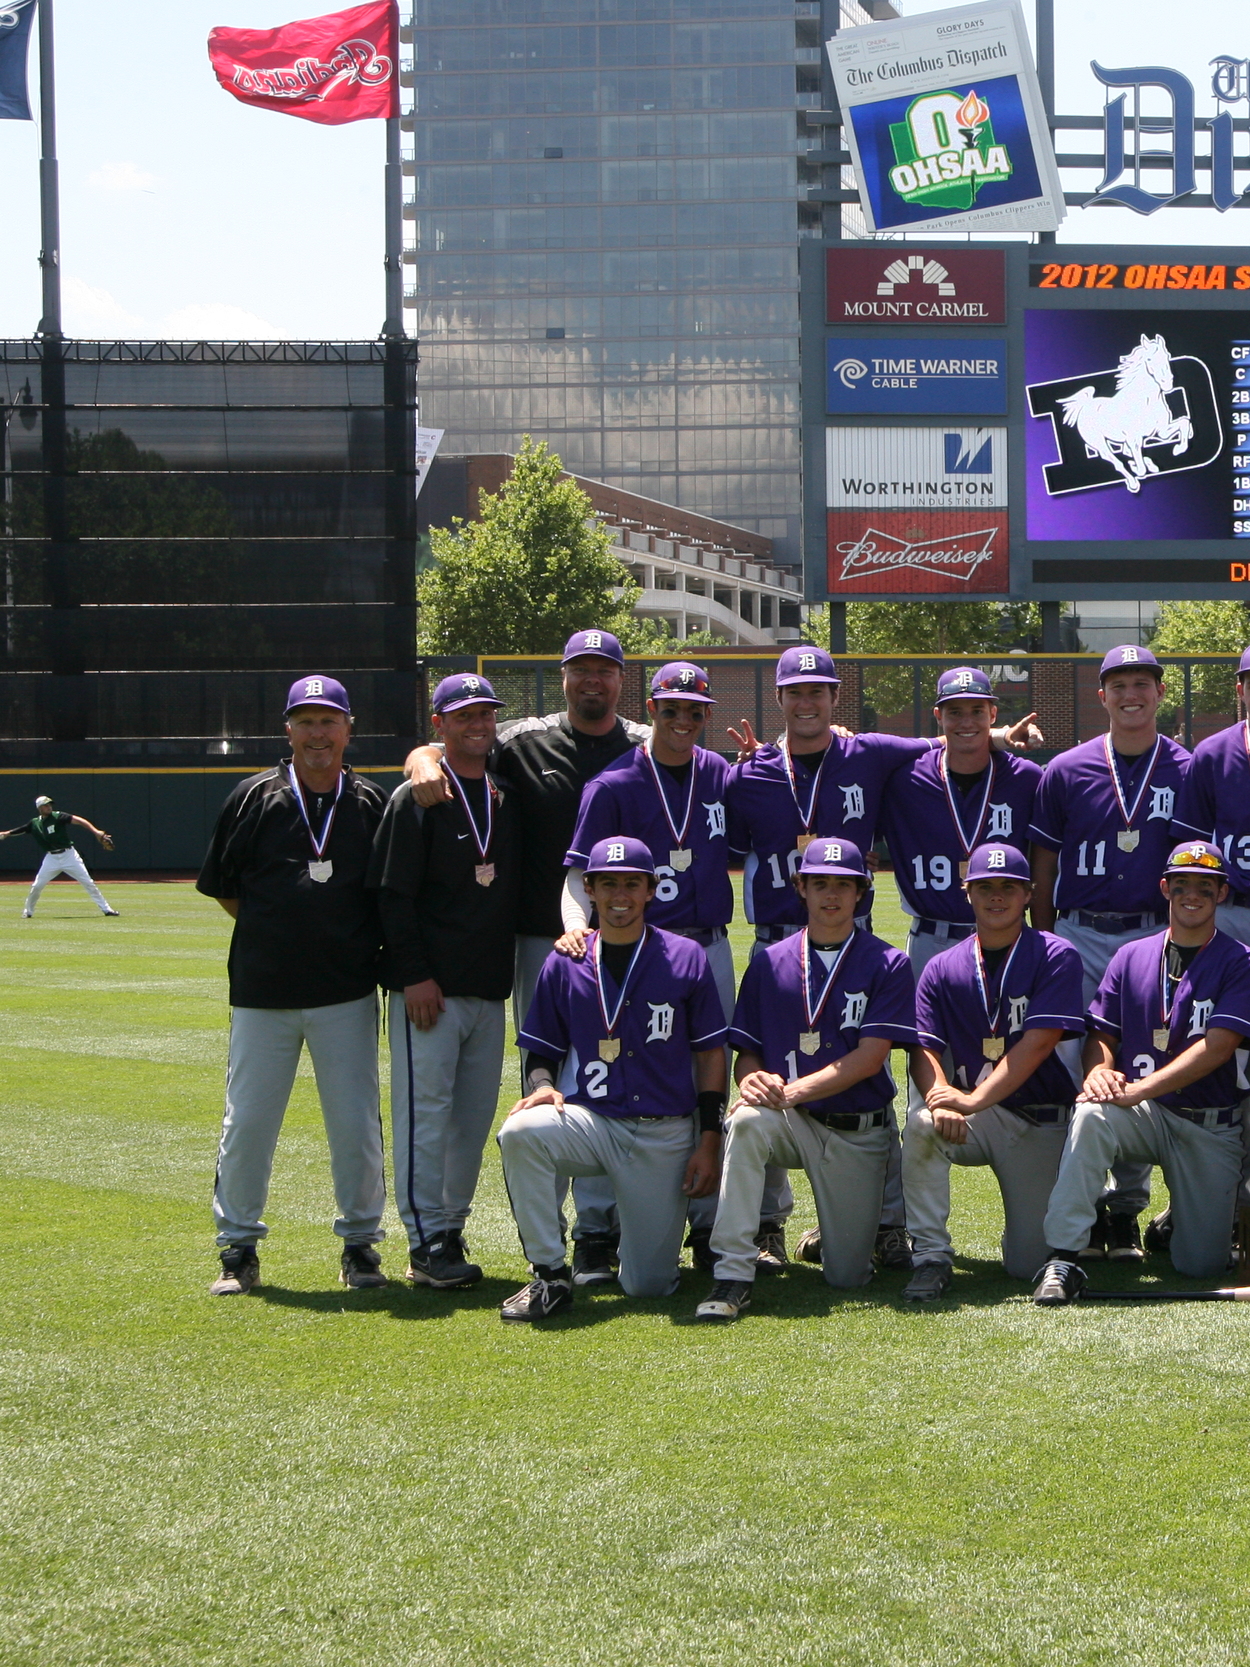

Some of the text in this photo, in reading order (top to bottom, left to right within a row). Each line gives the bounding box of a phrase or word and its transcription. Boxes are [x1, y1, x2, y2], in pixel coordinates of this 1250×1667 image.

[936, 23, 962, 35] GLORY
[964, 18, 985, 29] DAYS
[867, 38, 888, 46] ONLINE
[846, 41, 1008, 87] The Columbus Dispatch
[890, 146, 1012, 194] OHSAA
[926, 221, 943, 230] Park
[944, 216, 966, 228] Opens
[968, 209, 1004, 222] Columbus
[1004, 203, 1035, 216] Clippers
[1036, 199, 1051, 209] Win
[1039, 264, 1119, 289] 2012
[1123, 264, 1226, 290] OHSAA
[844, 302, 989, 317] MOUNT CARMEL
[1231, 347, 1250, 359] CF
[871, 359, 998, 375] TIME WARNER
[1235, 368, 1246, 380] C
[872, 379, 918, 388] CABLE
[1232, 391, 1250, 403] 2B
[1232, 413, 1250, 424] 3B
[1237, 434, 1246, 446] P
[1233, 455, 1250, 467] RF
[1233, 477, 1250, 489] 1B
[912, 498, 994, 506] INDUSTRIES
[836, 541, 993, 567] Budweiser
[702, 800, 727, 841] D
[986, 802, 1013, 839] D
[606, 843, 625, 863] D
[823, 844, 843, 862] D
[987, 849, 1006, 870] D
[1076, 840, 1107, 876] 11
[912, 854, 952, 891] 19
[839, 991, 869, 1030] D
[646, 1001, 675, 1044] D
[584, 1060, 608, 1099] 2
